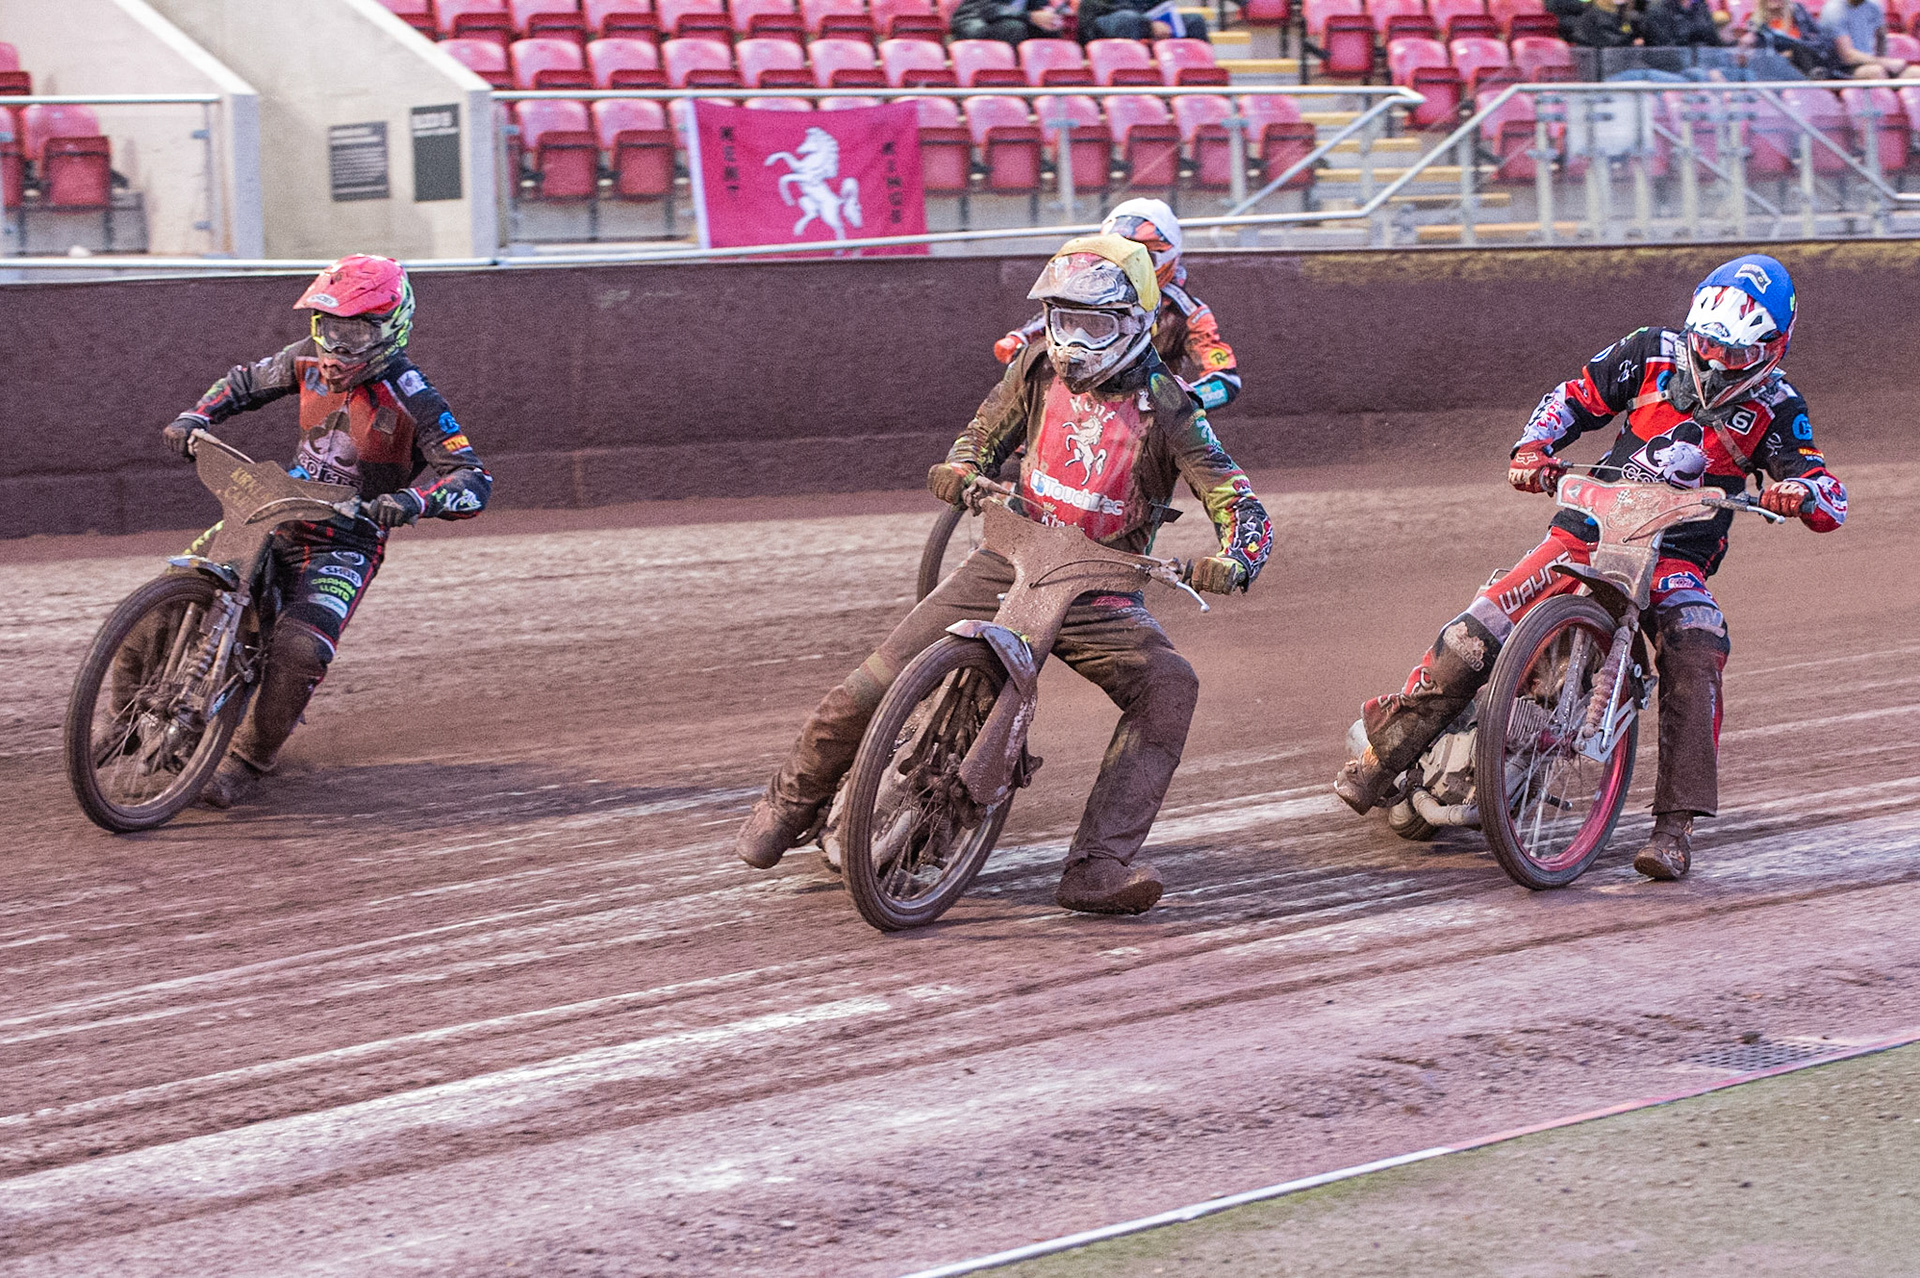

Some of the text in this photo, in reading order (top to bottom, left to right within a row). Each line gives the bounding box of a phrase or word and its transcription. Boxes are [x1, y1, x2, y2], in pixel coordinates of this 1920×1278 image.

[1069, 395, 1116, 423] Kent
[1732, 411, 1751, 433] 6
[325, 566, 361, 585] SHOEI
[312, 578, 356, 597] GRAHAM
[320, 585, 350, 602] LLOYD
